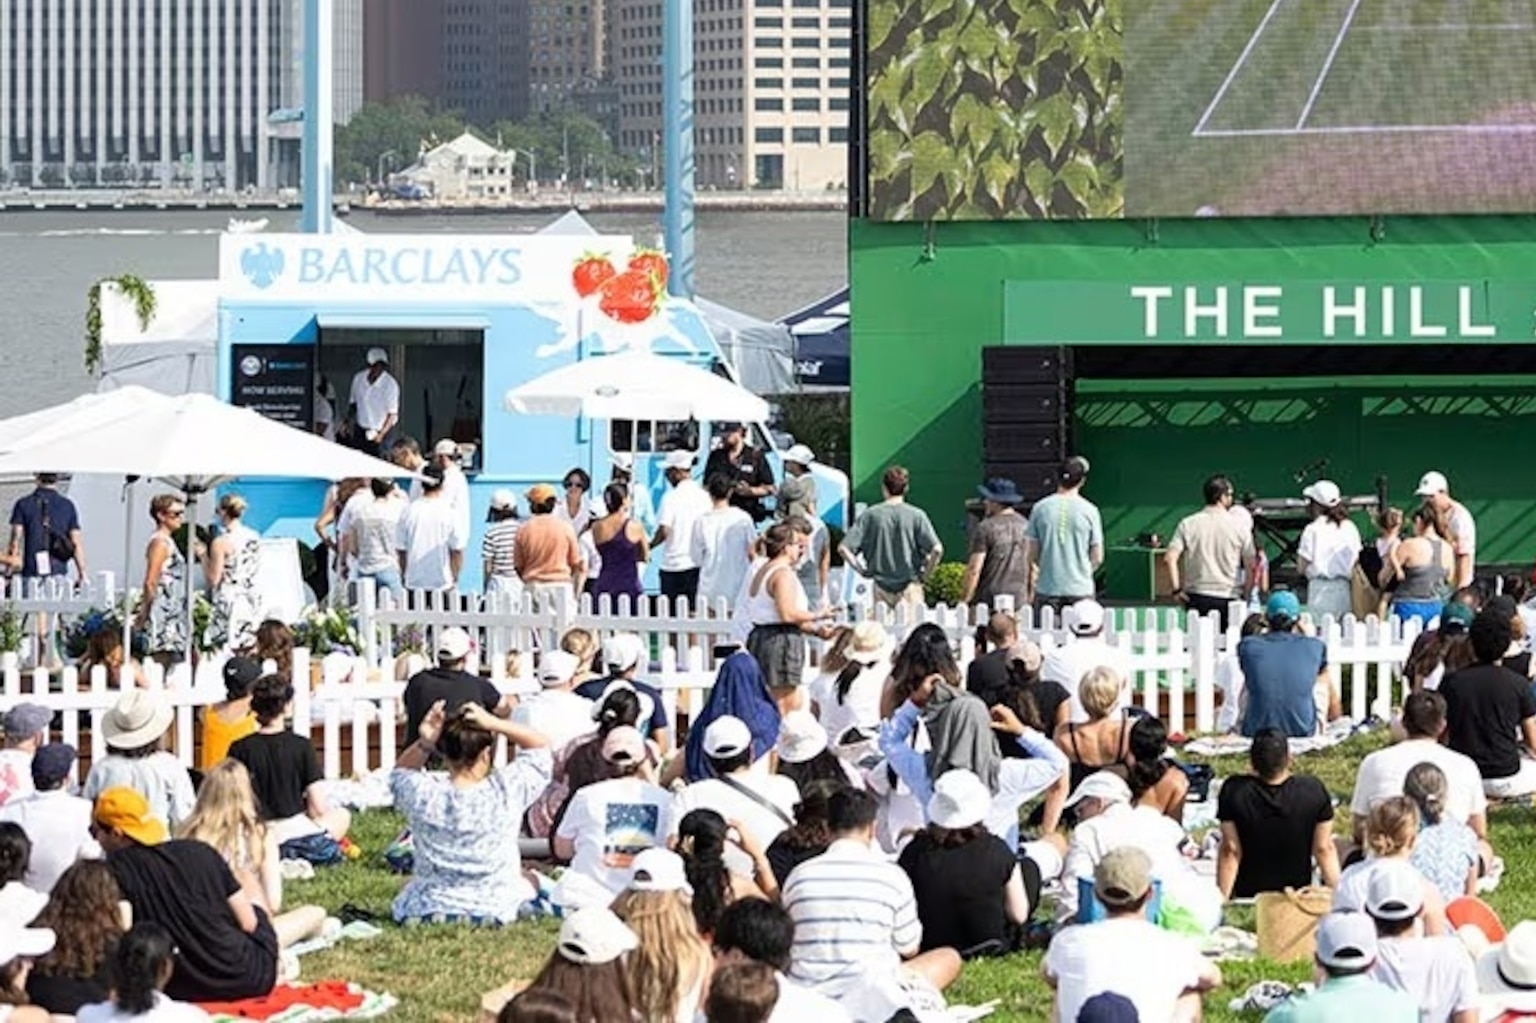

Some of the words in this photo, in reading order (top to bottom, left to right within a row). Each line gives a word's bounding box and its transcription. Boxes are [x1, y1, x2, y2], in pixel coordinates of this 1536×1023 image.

[298, 247, 522, 285] BARCLAYS
[1131, 286, 1283, 337] THE
[1323, 286, 1496, 337] HILL
